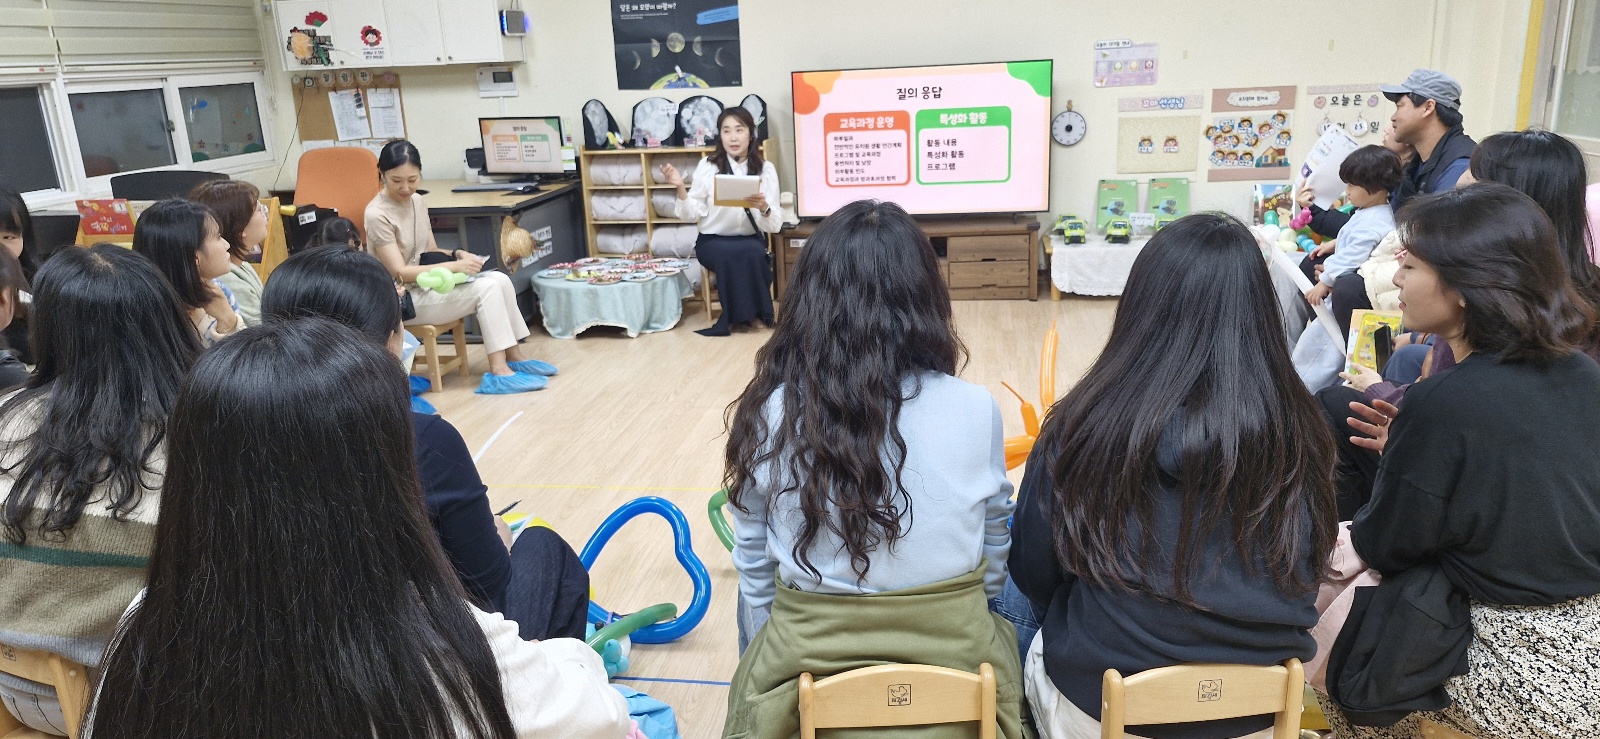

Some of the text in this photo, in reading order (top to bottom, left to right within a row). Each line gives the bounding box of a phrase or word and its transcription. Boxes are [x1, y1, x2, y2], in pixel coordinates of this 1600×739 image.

[896, 85, 943, 101] 질의 응답
[1330, 94, 1363, 107] 오늘은
[839, 115, 895, 129] 교육과정 운영
[939, 112, 988, 126] 특성화 활동
[926, 138, 957, 148] 활동 내용
[926, 150, 965, 159] 특성화 활동
[926, 162, 956, 171] 프로그램
